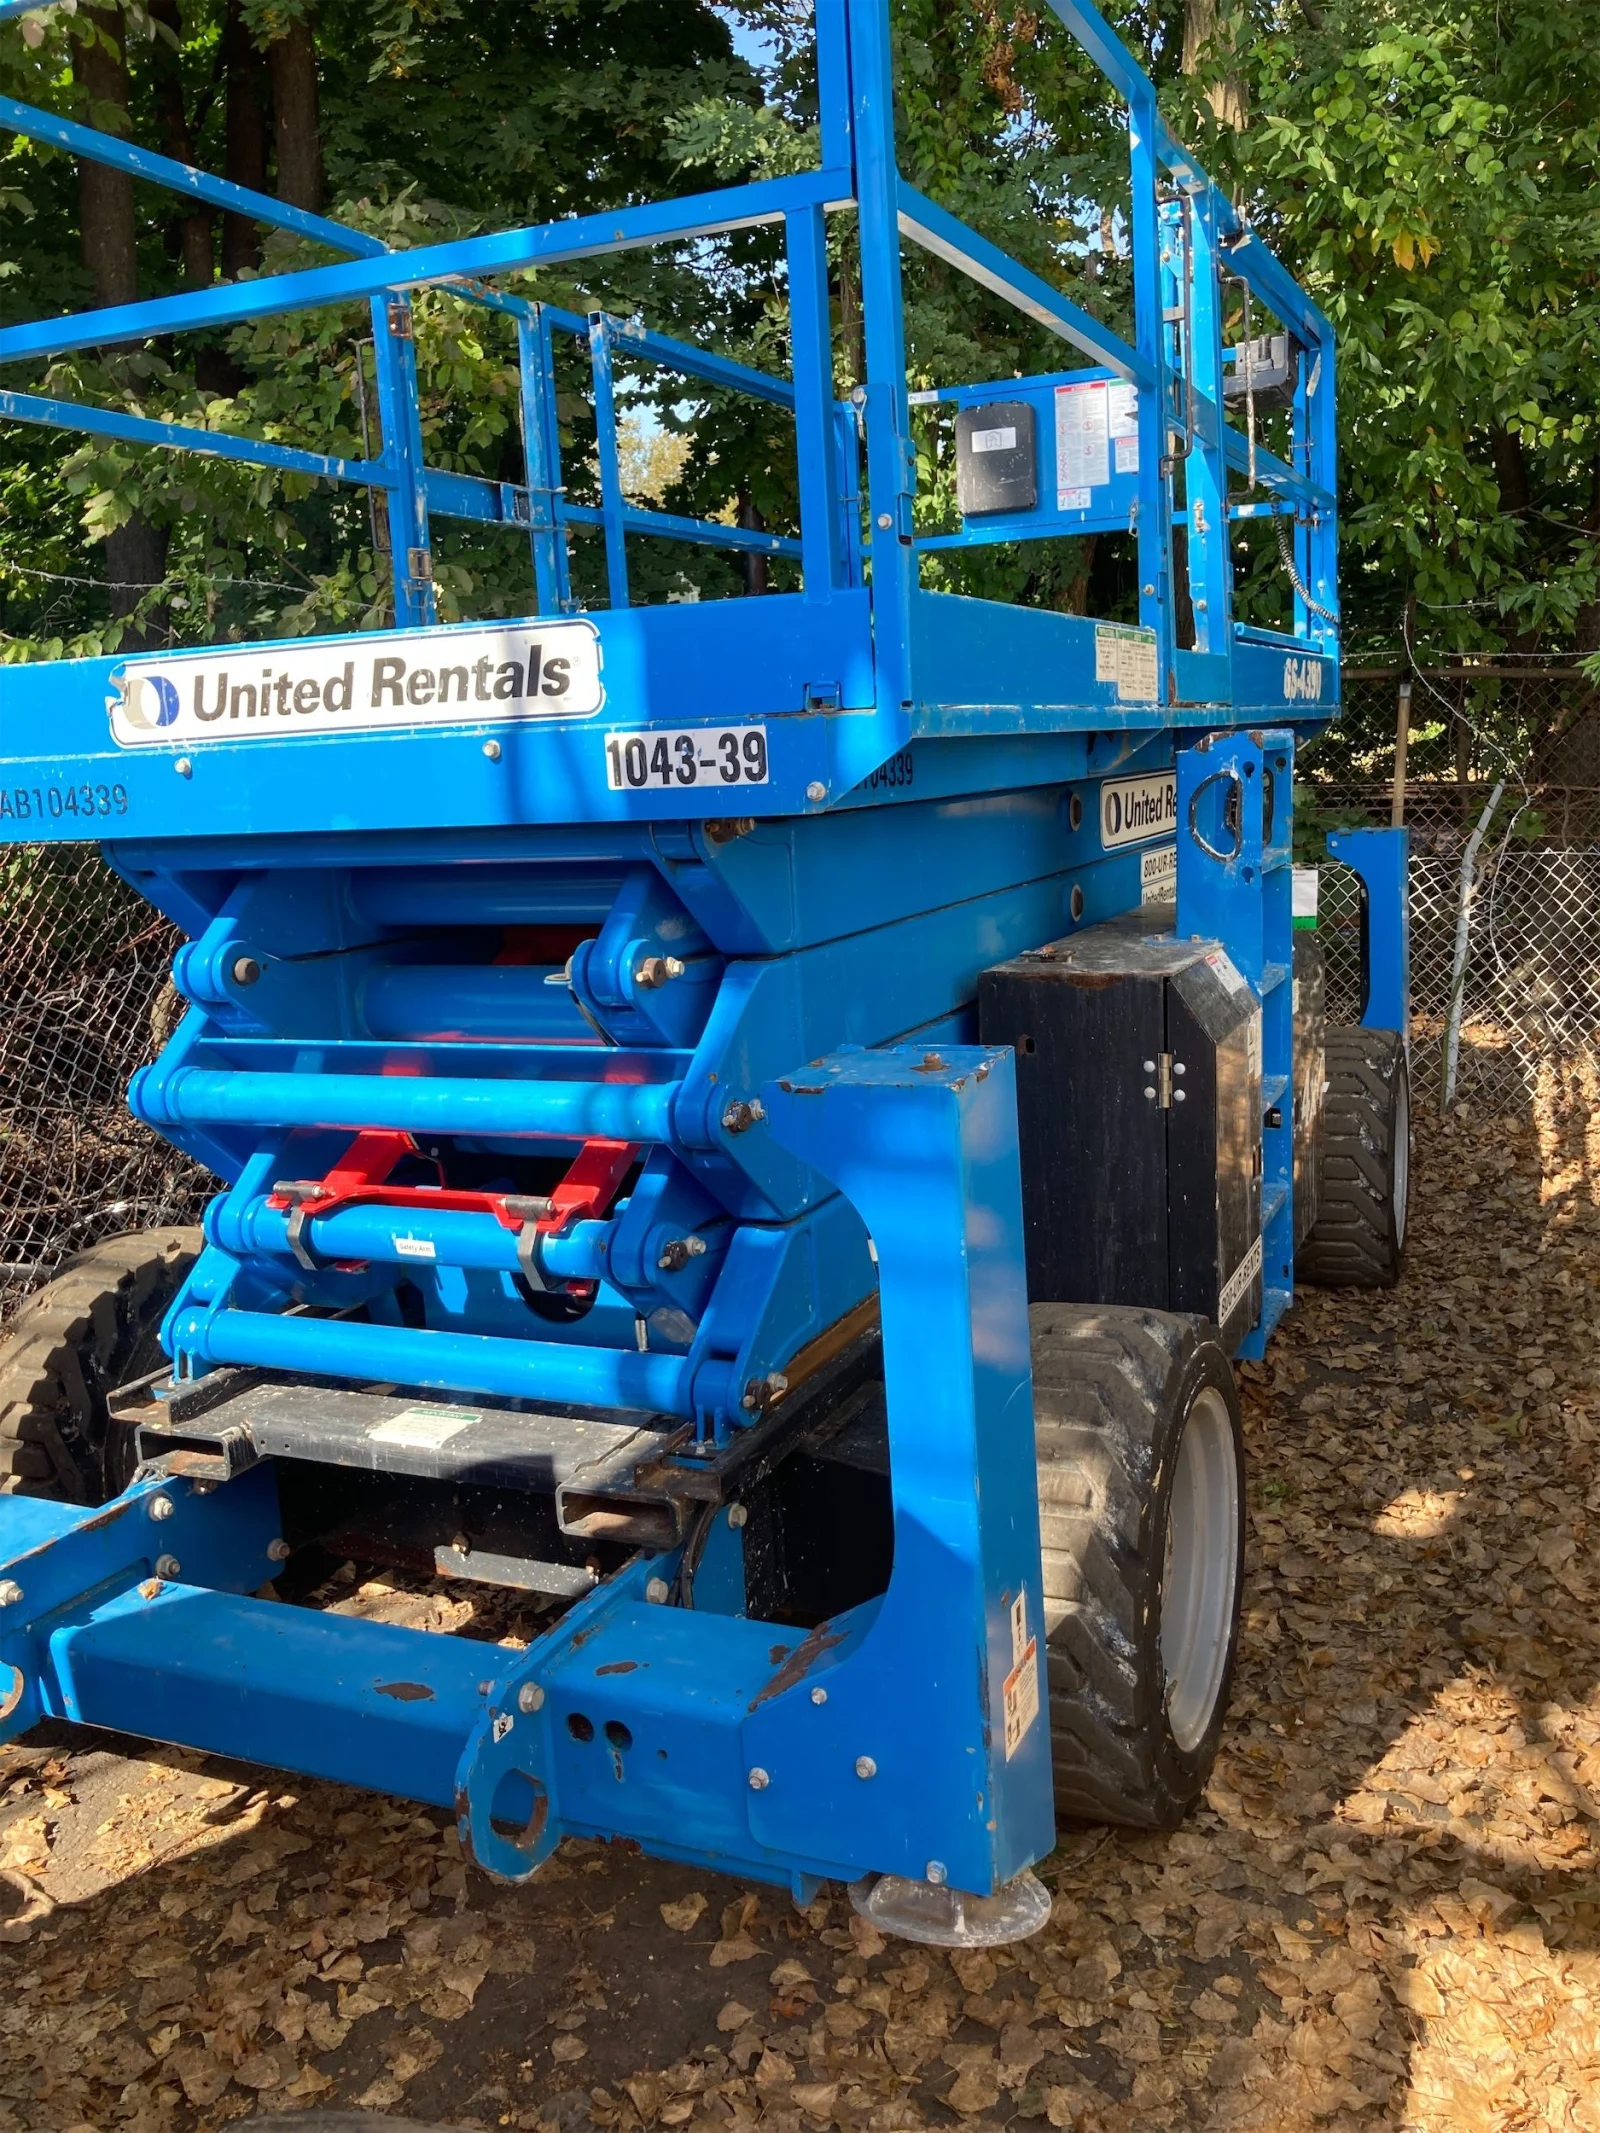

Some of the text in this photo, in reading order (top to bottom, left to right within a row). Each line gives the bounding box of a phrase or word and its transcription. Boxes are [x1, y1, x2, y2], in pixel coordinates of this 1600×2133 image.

[193, 644, 571, 722] United Rentals
[606, 731, 768, 787] 1043-39
[1124, 786, 1163, 829] United
[399, 1243, 418, 1253] Safety
